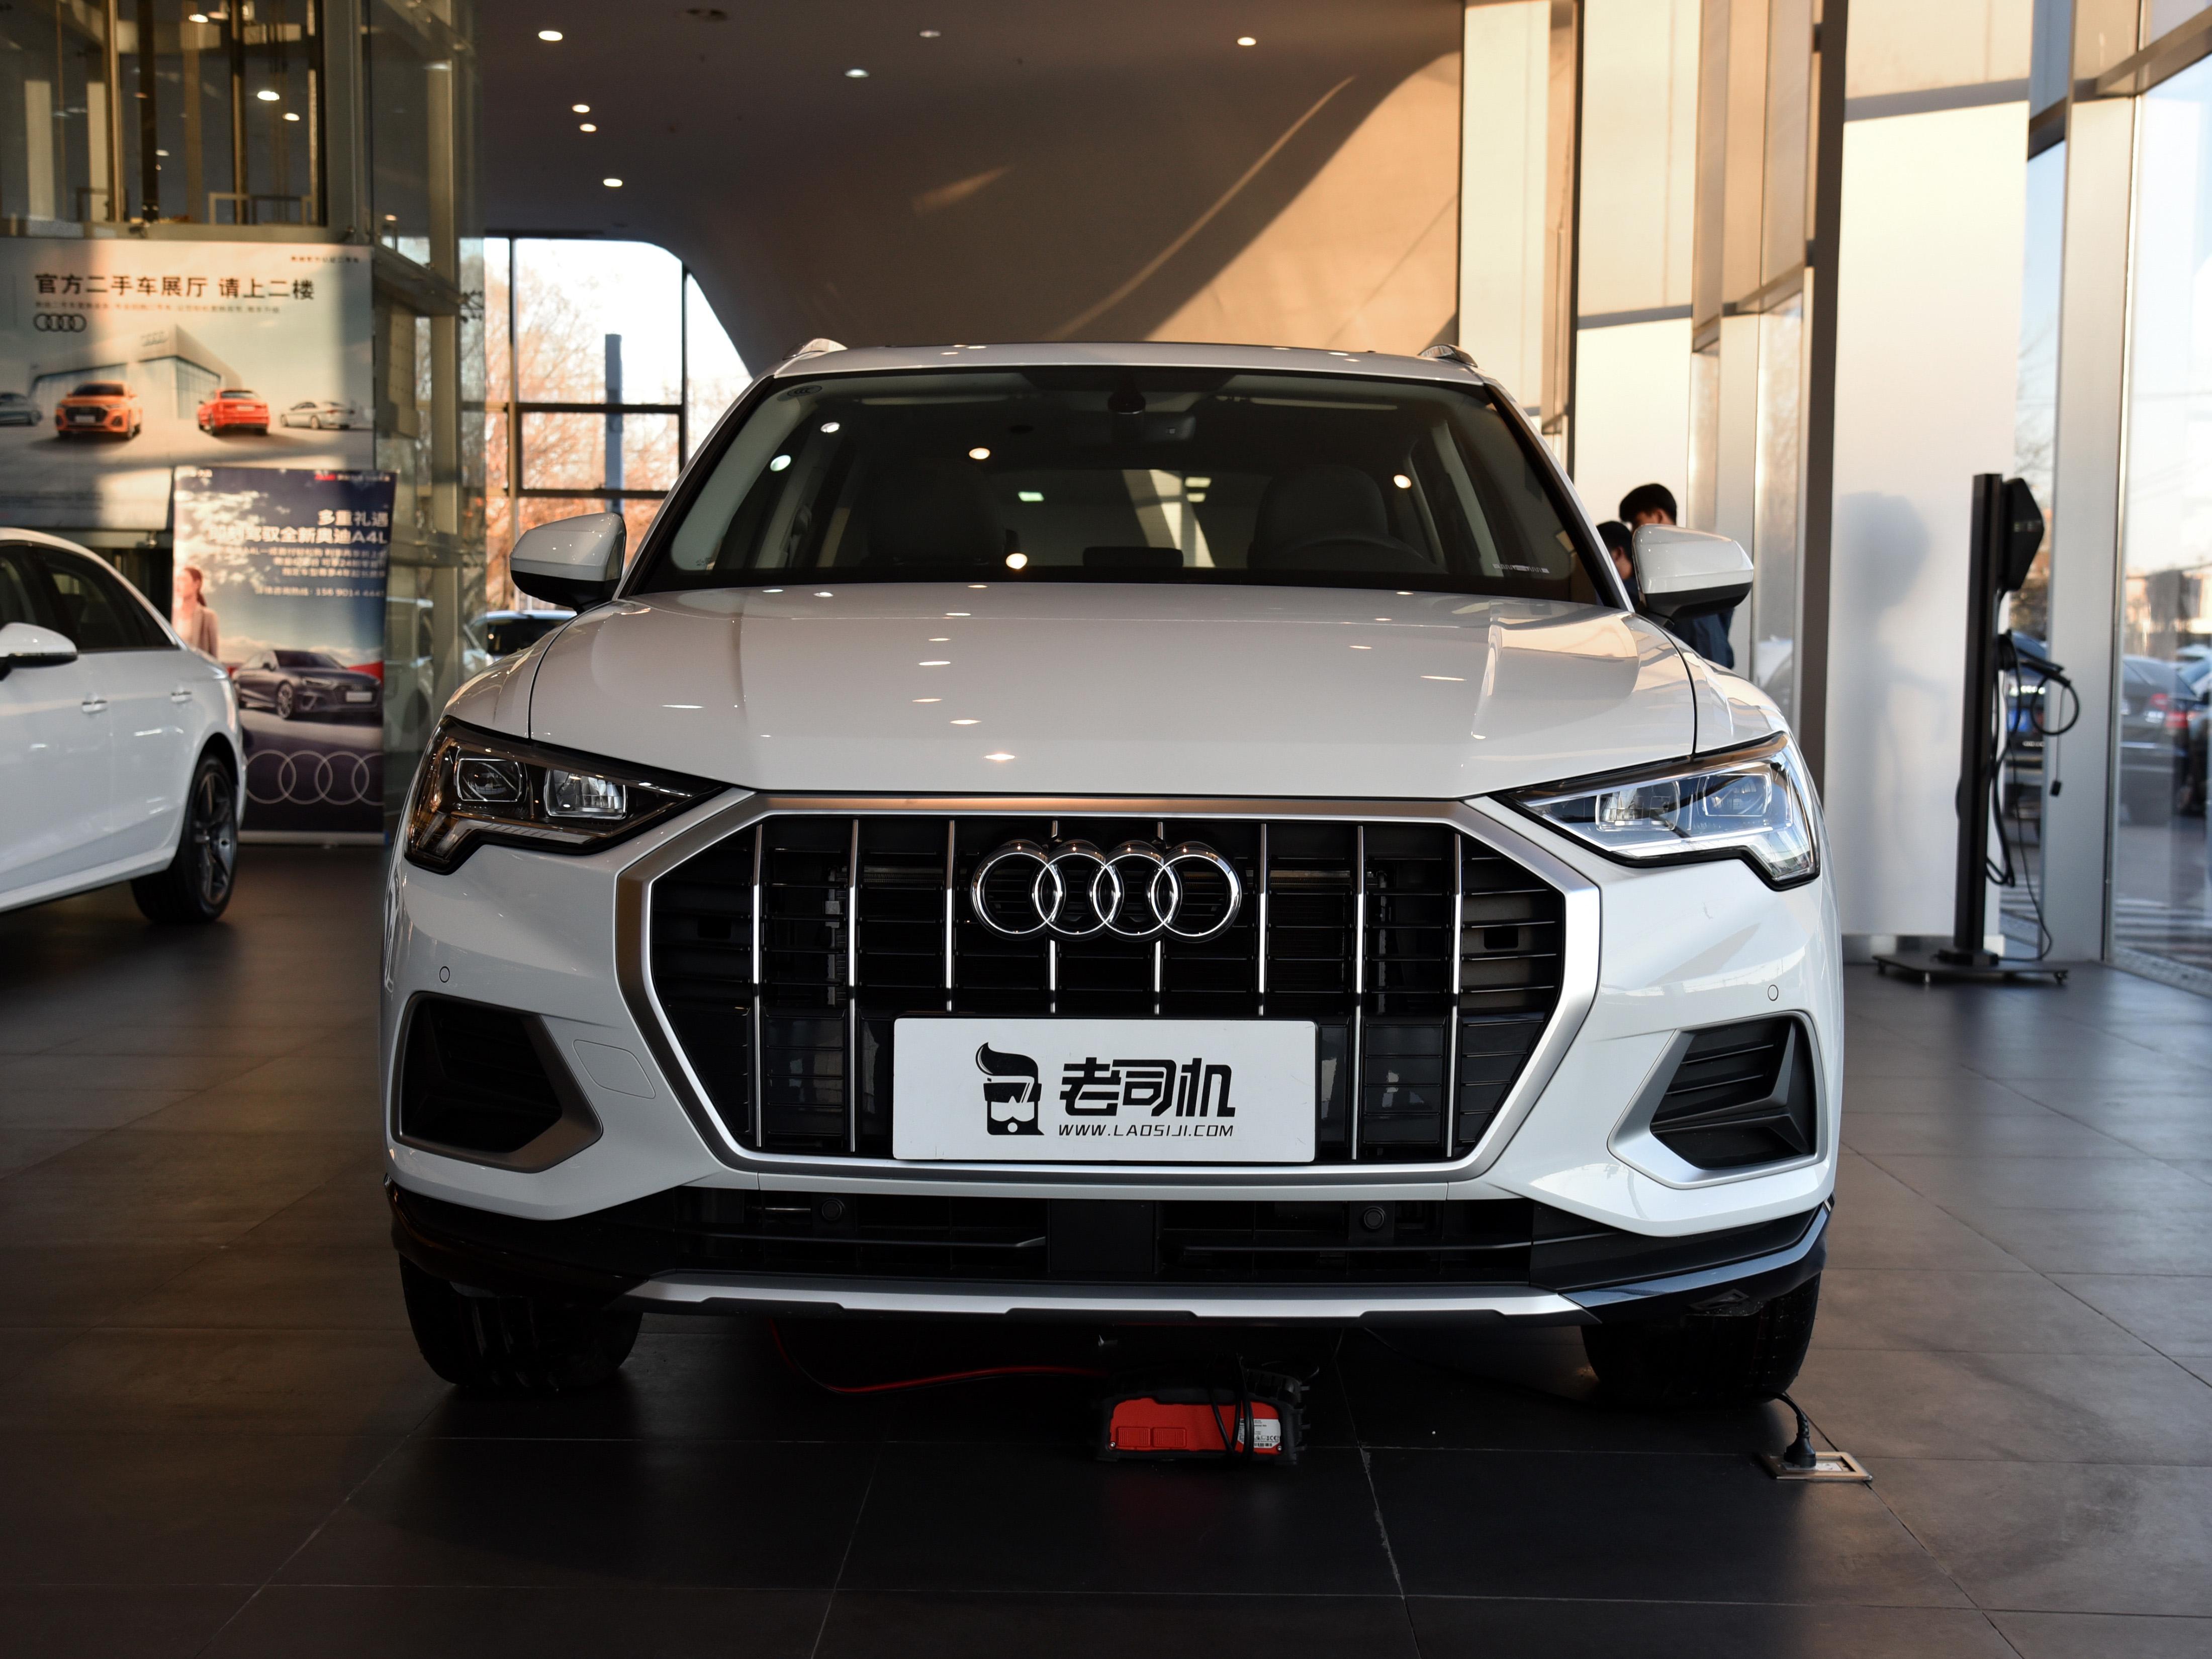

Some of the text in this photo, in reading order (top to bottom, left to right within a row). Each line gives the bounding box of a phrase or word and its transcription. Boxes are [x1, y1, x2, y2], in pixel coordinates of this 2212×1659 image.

[35, 273, 315, 300] 官方二手车展厅 请上二楼
[318, 509, 389, 527] 多重礼遇
[1059, 1057, 1236, 1117] 老司机
[1059, 1124, 1234, 1137] WWW.LAOSIJI.COM
